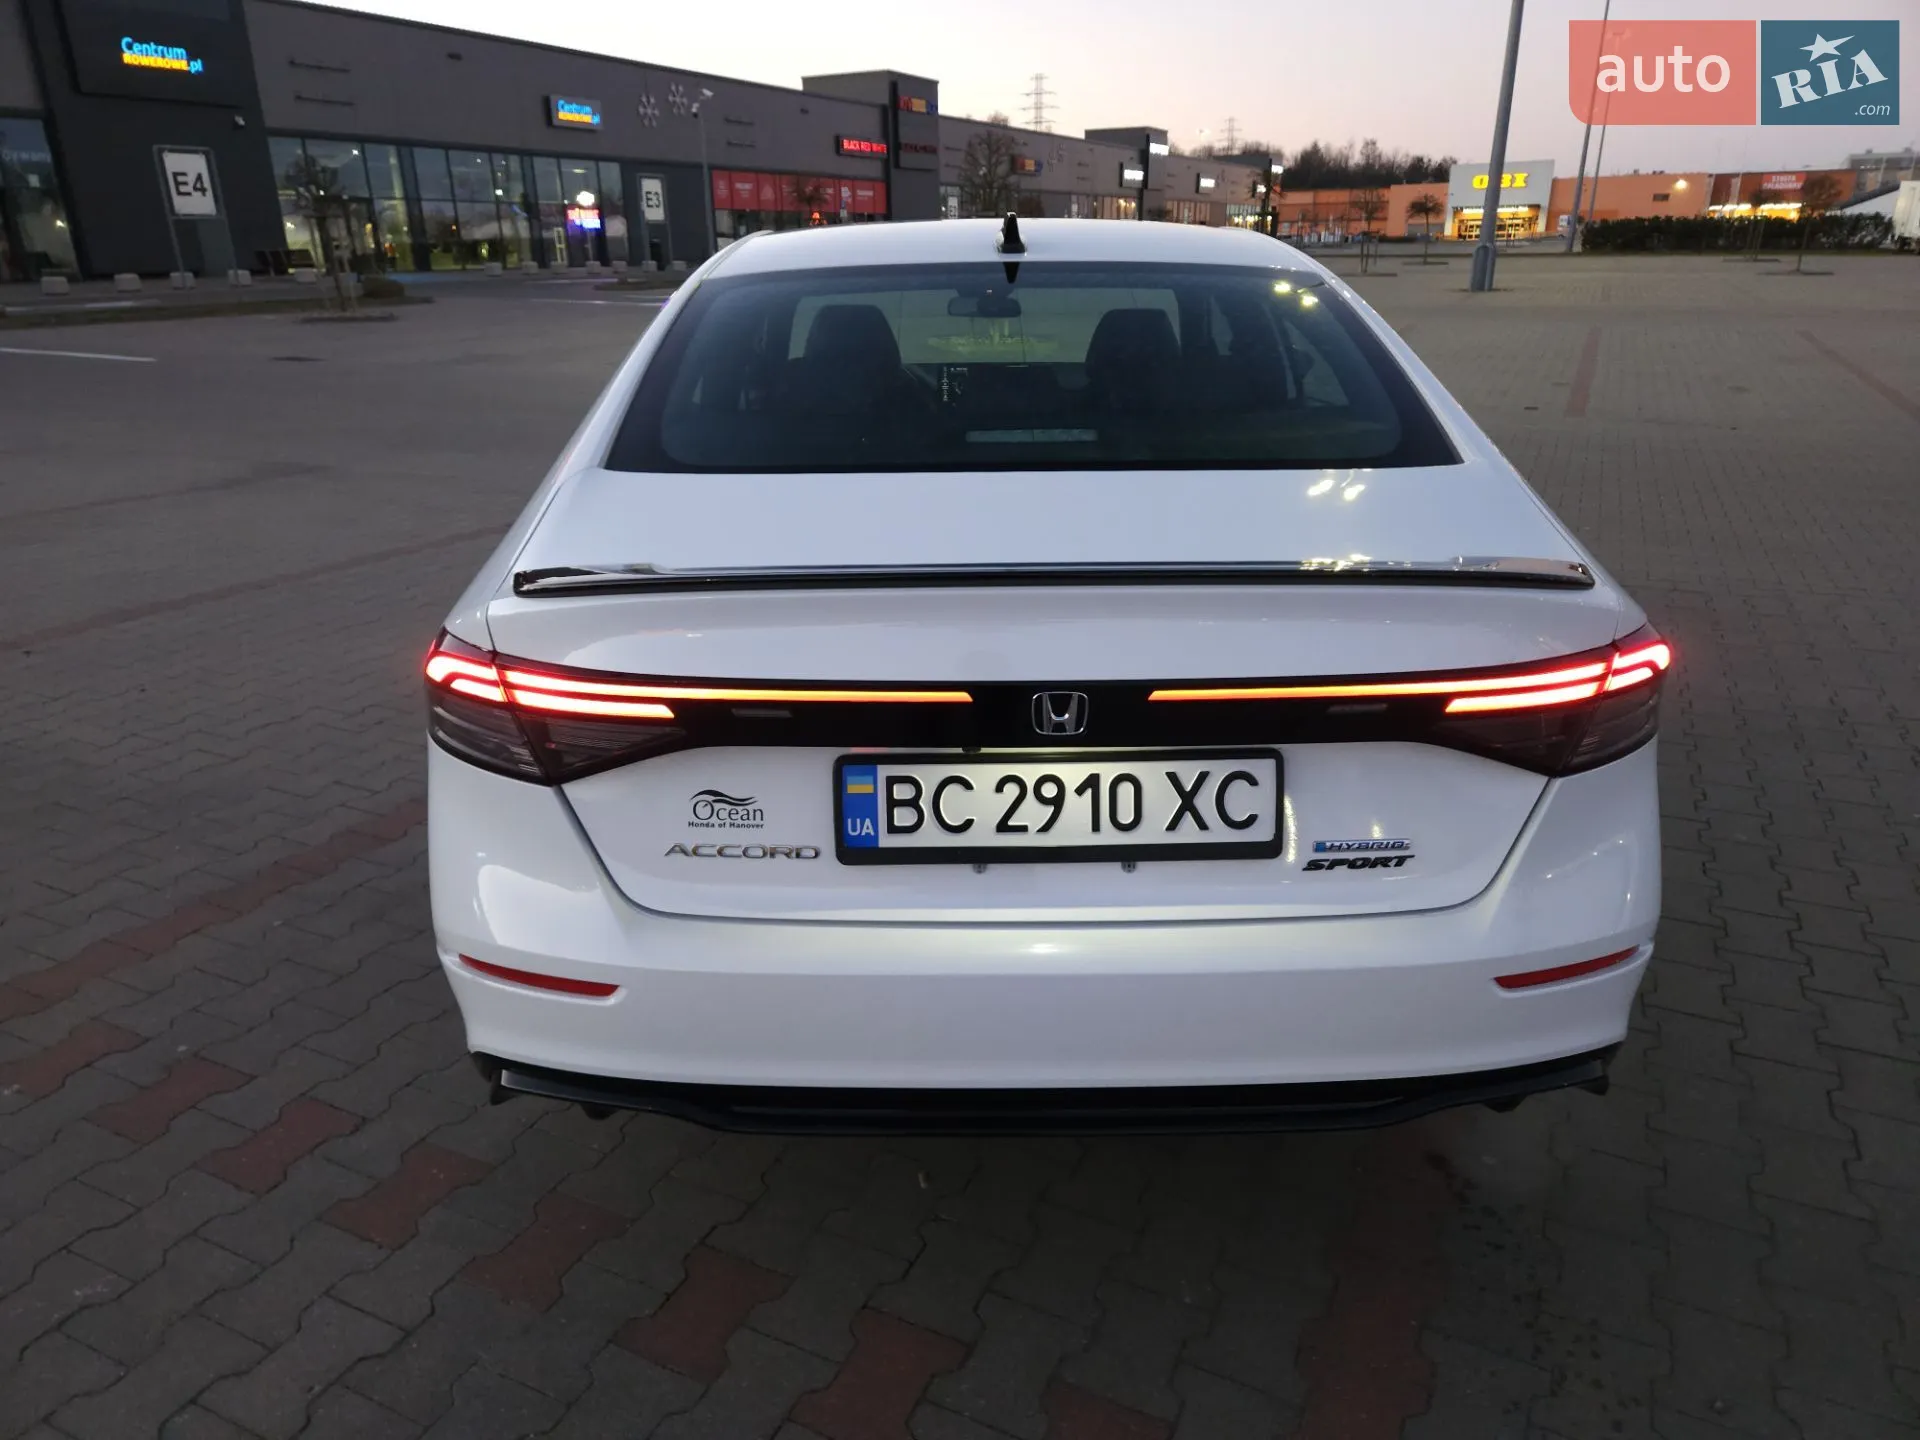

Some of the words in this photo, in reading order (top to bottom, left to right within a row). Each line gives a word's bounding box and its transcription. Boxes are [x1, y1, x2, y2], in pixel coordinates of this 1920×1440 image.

[121, 37, 187, 59] Centrum
[172, 171, 208, 197] E4
[1472, 172, 1529, 189] OBI
[645, 191, 661, 208] E3
[693, 799, 764, 822] Ocean
[885, 775, 975, 834] BC
[995, 773, 1142, 833] 2910
[1165, 770, 1260, 831] XC
[729, 821, 764, 829] Hanover
[847, 817, 875, 837] UA
[664, 843, 821, 860] ACCORD
[1327, 841, 1405, 851] HYBRID
[1302, 855, 1415, 871] SPORT
